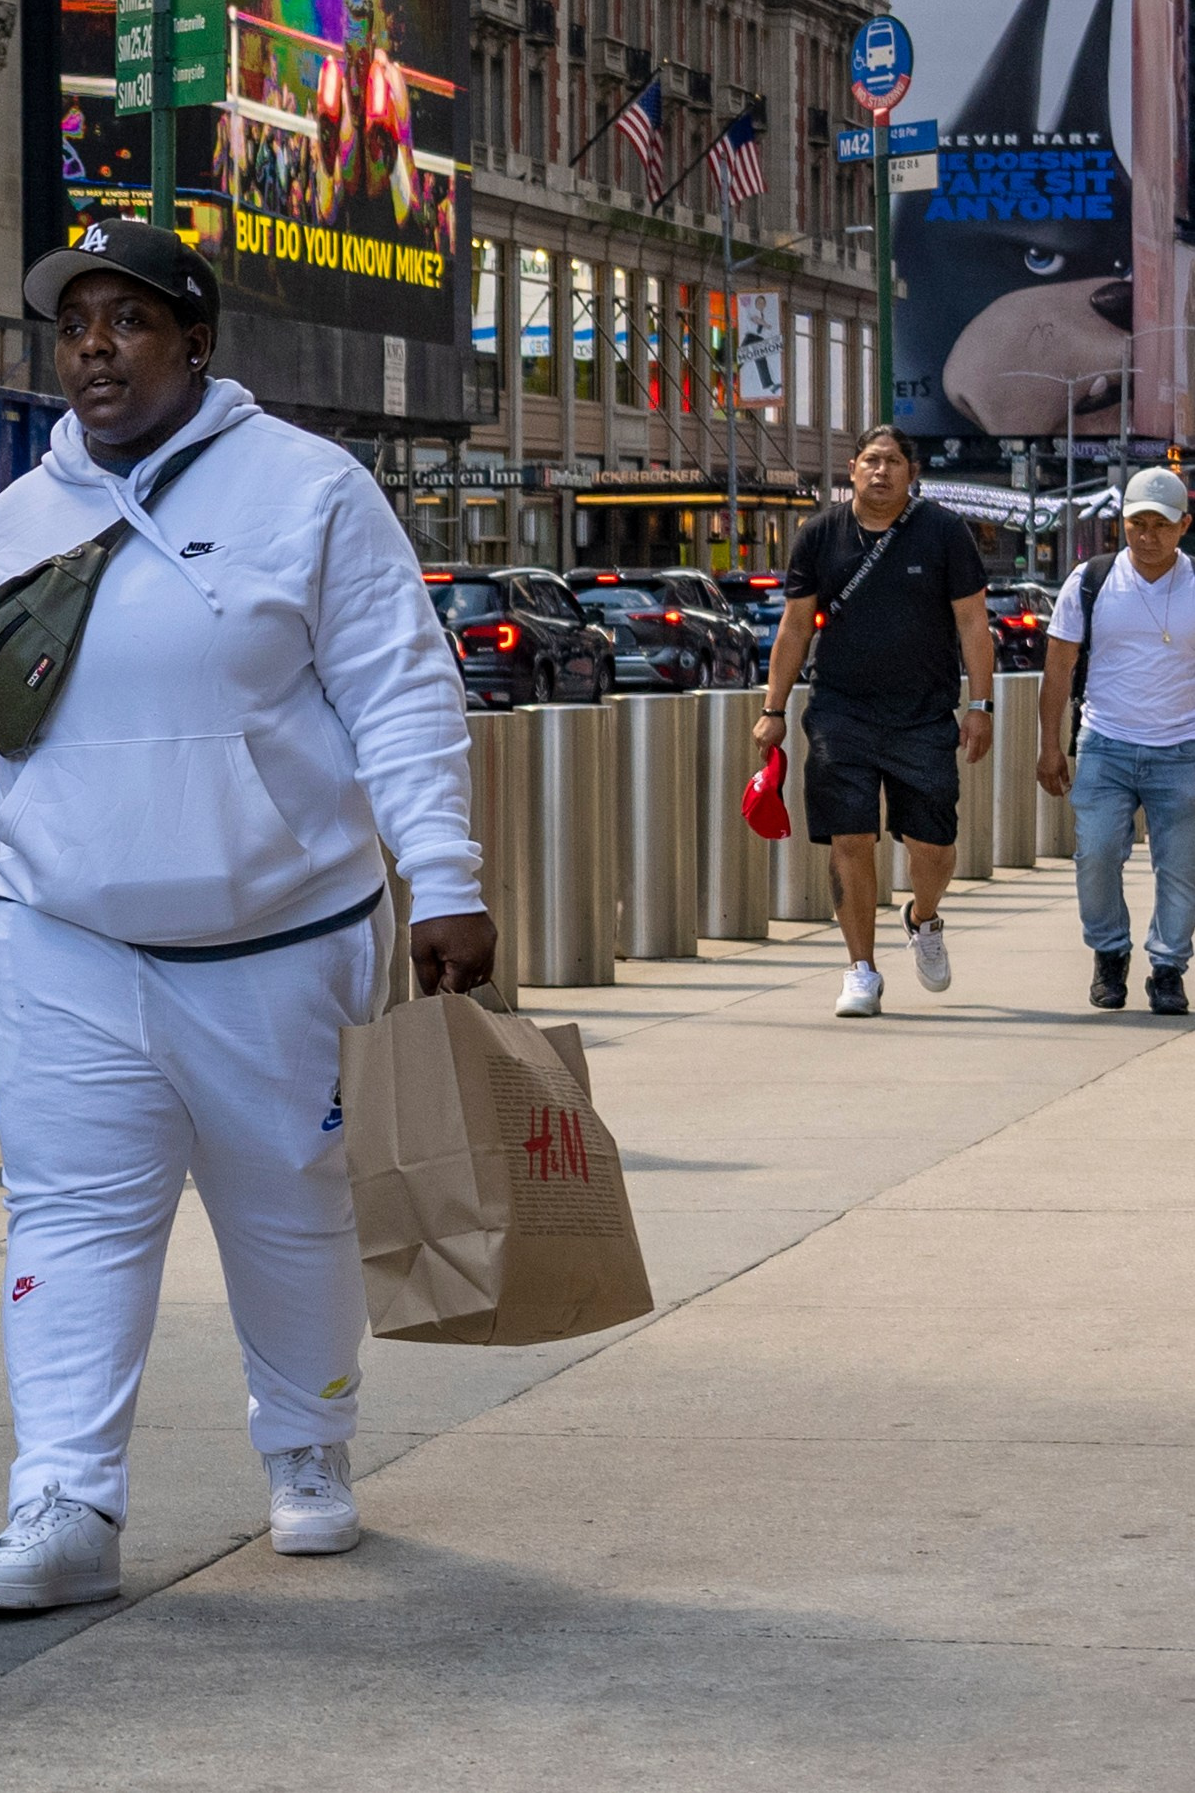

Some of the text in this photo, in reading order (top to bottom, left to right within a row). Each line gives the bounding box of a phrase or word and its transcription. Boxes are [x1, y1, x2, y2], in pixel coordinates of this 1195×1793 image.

[173, 13, 206, 33] Tottenville
[173, 64, 205, 83] Sunnyside
[118, 72, 152, 110] SIM30
[856, 83, 906, 107] NO STANDING
[840, 133, 870, 157] M42
[939, 133, 1100, 146] KEVIN HART
[974, 151, 1114, 170] DOESN'T
[1044, 171, 1115, 195] SIT
[924, 195, 1113, 221] ANYONE
[79, 223, 109, 253] LA
[236, 210, 443, 289] BUT DO YOU KNOW MIKE?
[738, 341, 783, 362] MORMON
[892, 376, 931, 397] ETS
[489, 468, 524, 485] Inn
[186, 542, 215, 551] NIKE
[839, 528, 897, 600] UNDER ARMOUR
[522, 1106, 589, 1184] H&M
